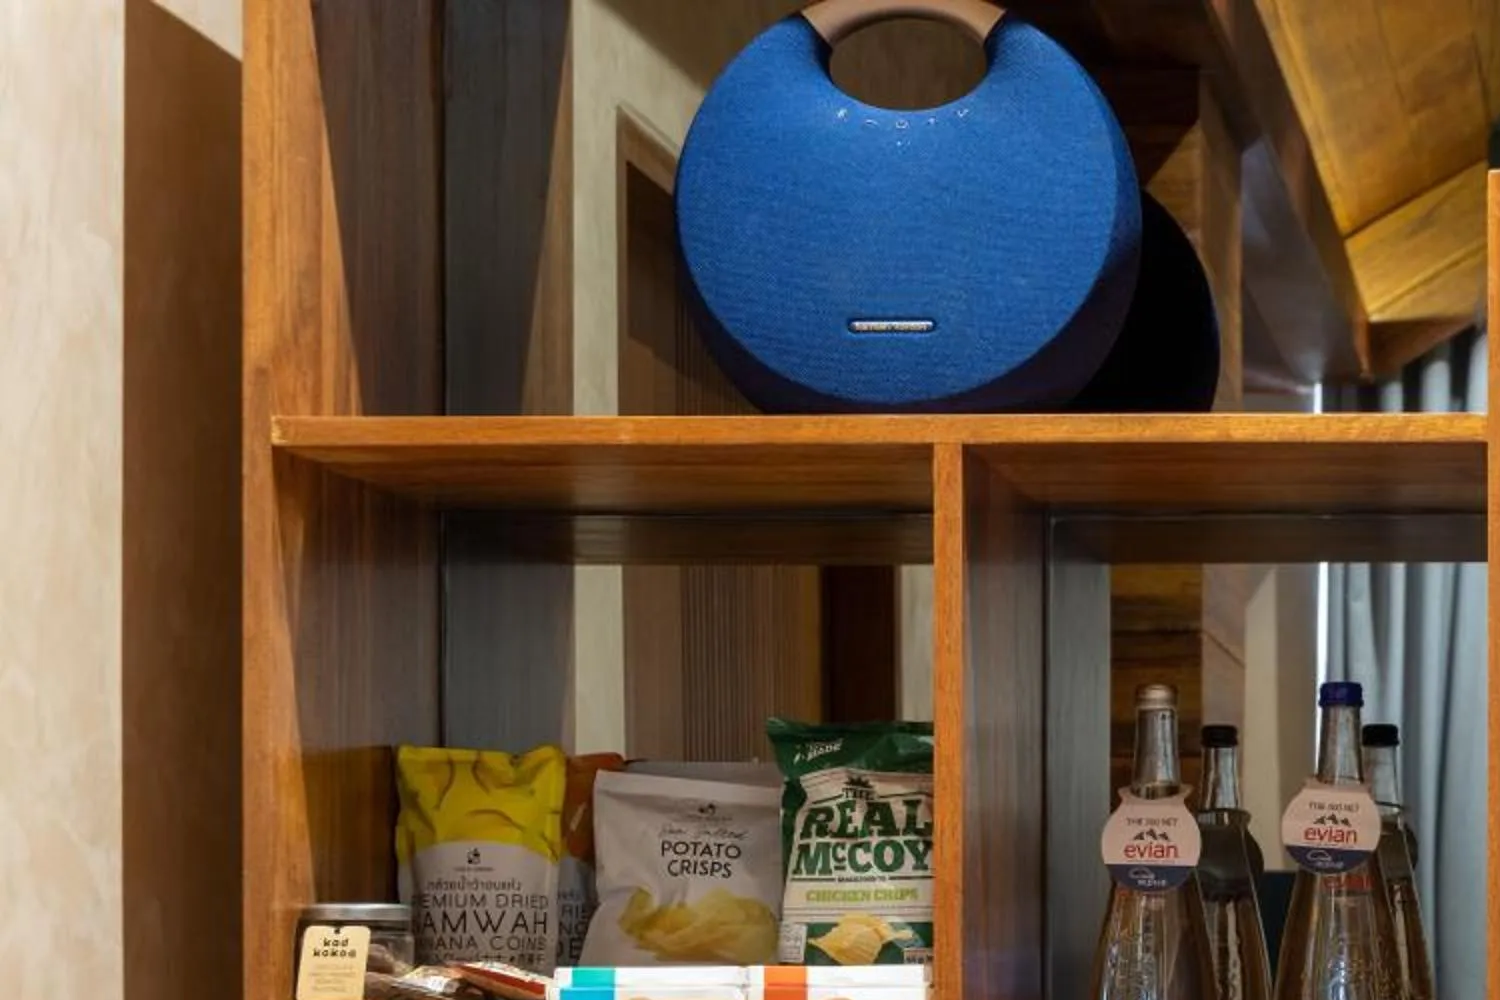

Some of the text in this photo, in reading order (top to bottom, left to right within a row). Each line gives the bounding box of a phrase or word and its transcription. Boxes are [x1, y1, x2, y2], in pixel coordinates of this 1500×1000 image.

[800, 800, 933, 839] REAL
[1304, 826, 1358, 844] evian
[661, 840, 741, 859] POTATO
[1124, 842, 1178, 859] evian
[667, 859, 732, 878] CRISPS
[495, 894, 550, 910] DRIED
[322, 937, 349, 947] kad
[489, 935, 547, 951] COINS
[312, 947, 357, 958] kokoa
